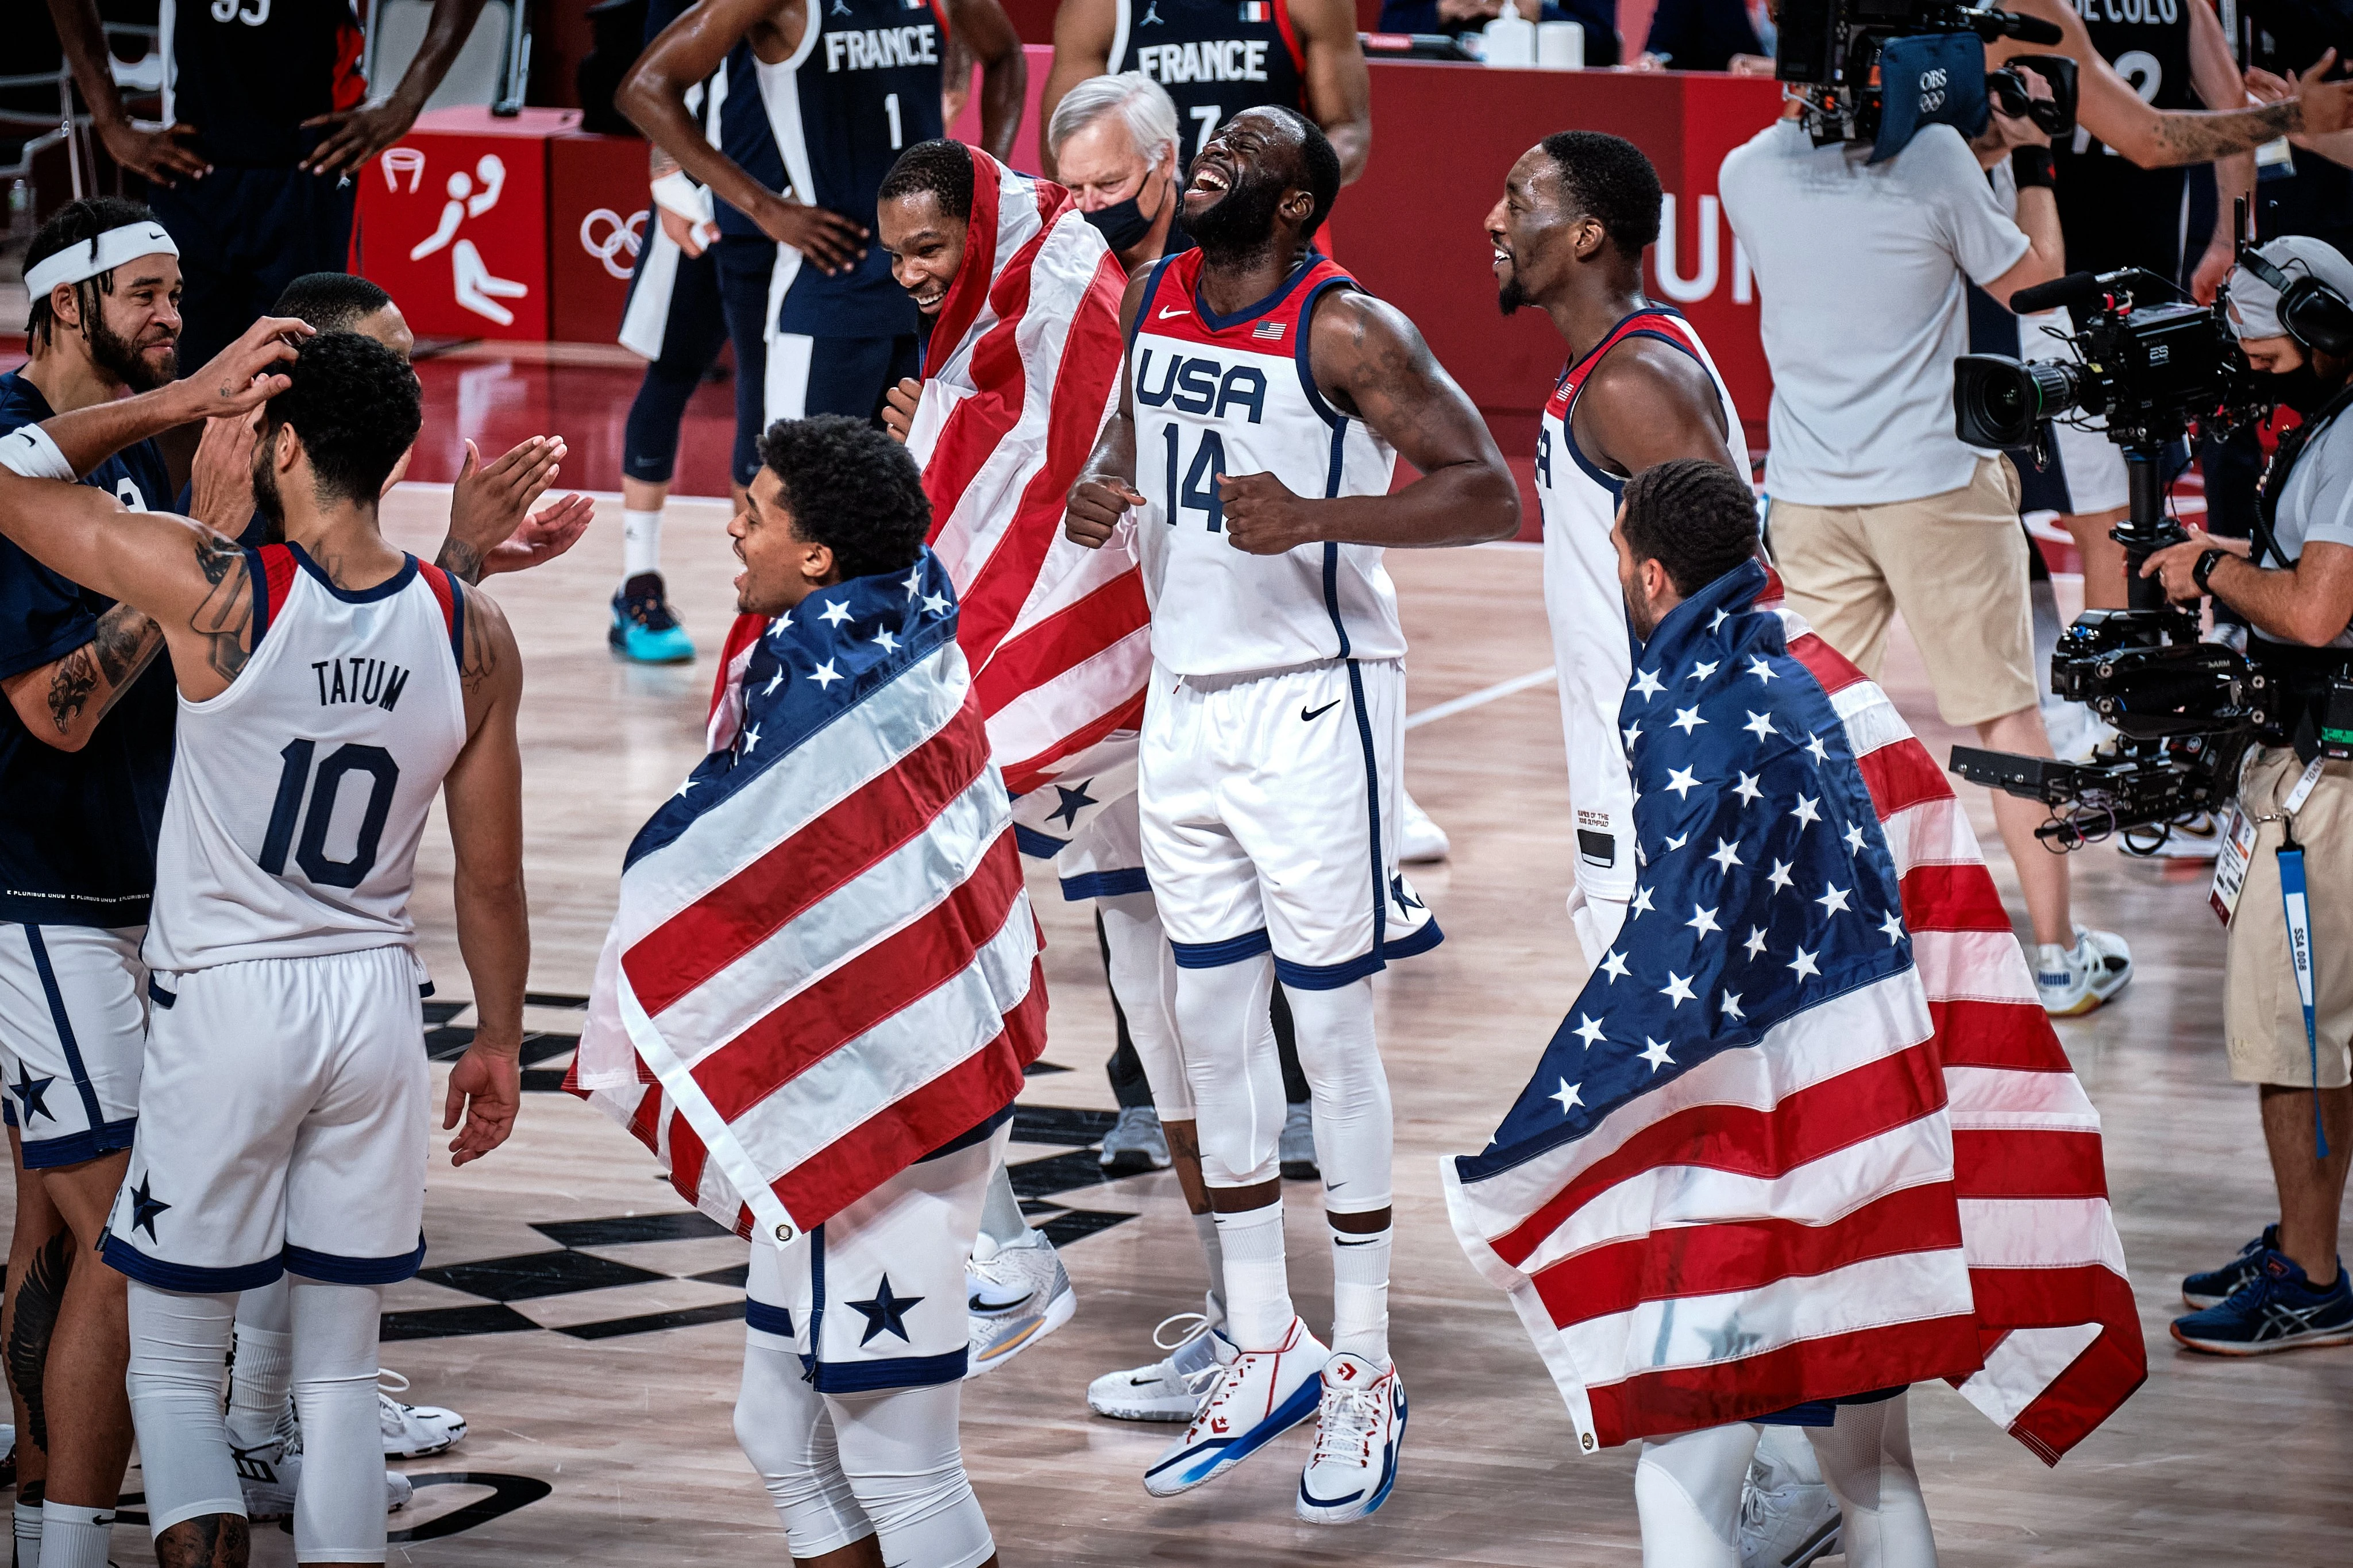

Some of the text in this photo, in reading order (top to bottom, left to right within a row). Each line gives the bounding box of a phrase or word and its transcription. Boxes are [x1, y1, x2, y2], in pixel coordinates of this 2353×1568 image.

[823, 24, 938, 73] FRANCE
[1137, 40, 1269, 85] FRANCE
[1919, 68, 1947, 91] OBS
[885, 94, 902, 150] 1
[1189, 105, 1222, 158] 7
[1136, 349, 1267, 424] USA
[1162, 423, 1226, 534] 14
[311, 658, 410, 712] TATUM
[258, 737, 400, 889] 10
[2294, 928, 2305, 948] SSA
